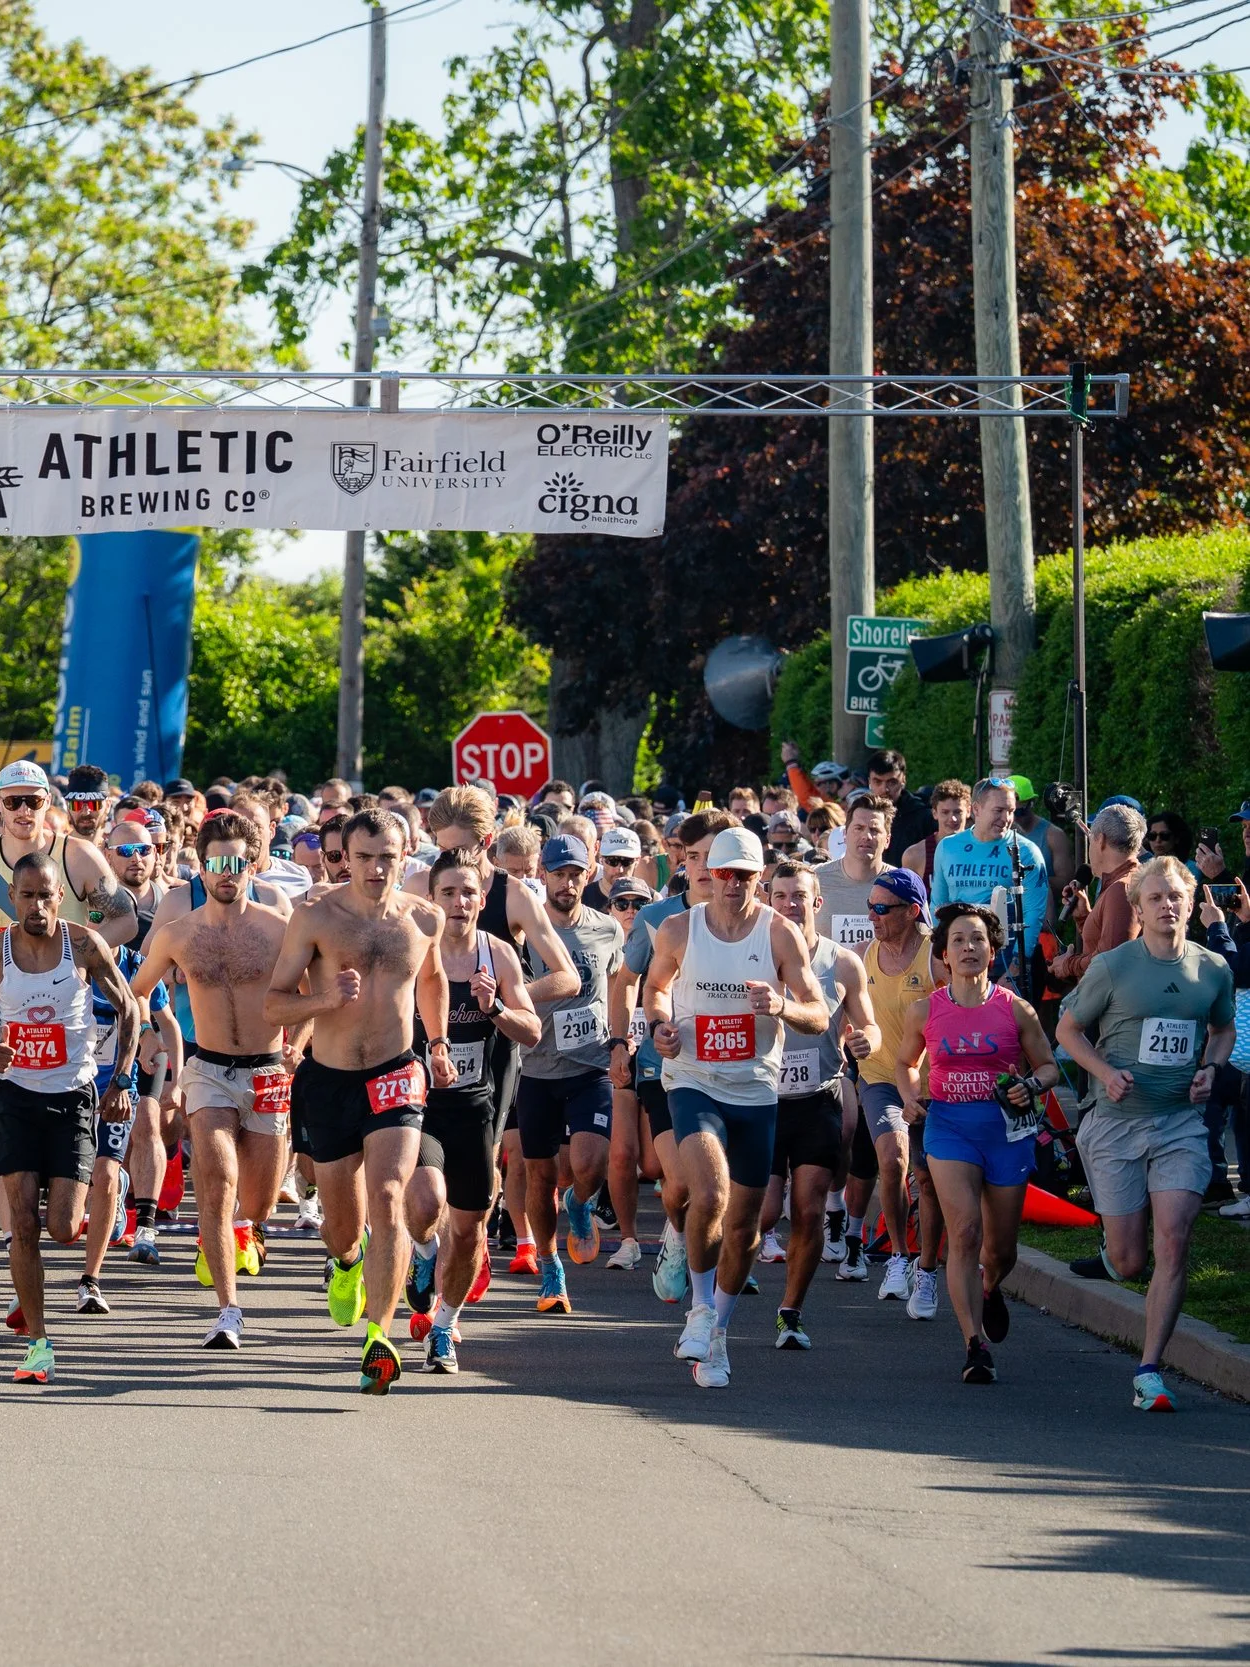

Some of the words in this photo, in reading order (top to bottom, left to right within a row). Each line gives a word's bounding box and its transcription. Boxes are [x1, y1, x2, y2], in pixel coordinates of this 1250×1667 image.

[38, 430, 294, 480] ATHLETIC
[537, 445, 633, 458] ELECTRIC
[381, 450, 507, 474] Fairfield
[382, 476, 506, 489] UNIVERSITY
[81, 489, 211, 518] BREWING
[538, 488, 639, 522] cigna
[591, 515, 638, 525] healthcare
[137, 699, 150, 727] and
[850, 696, 879, 711] BIKE
[62, 705, 83, 769] Balm
[133, 730, 148, 764] wind
[461, 742, 545, 781] STOP
[948, 864, 1009, 880] ATHLETIC
[955, 880, 987, 888] BREWING
[562, 1019, 598, 1039] 2304
[16, 1039, 57, 1058] 2874
[703, 1031, 747, 1050] 2865
[1149, 1035, 1188, 1054] 2130
[787, 1053, 810, 1061] ATHLETIC
[780, 1066, 810, 1084] 738
[948, 1072, 989, 1083] FORTIS
[942, 1081, 998, 1093] FORTUNA
